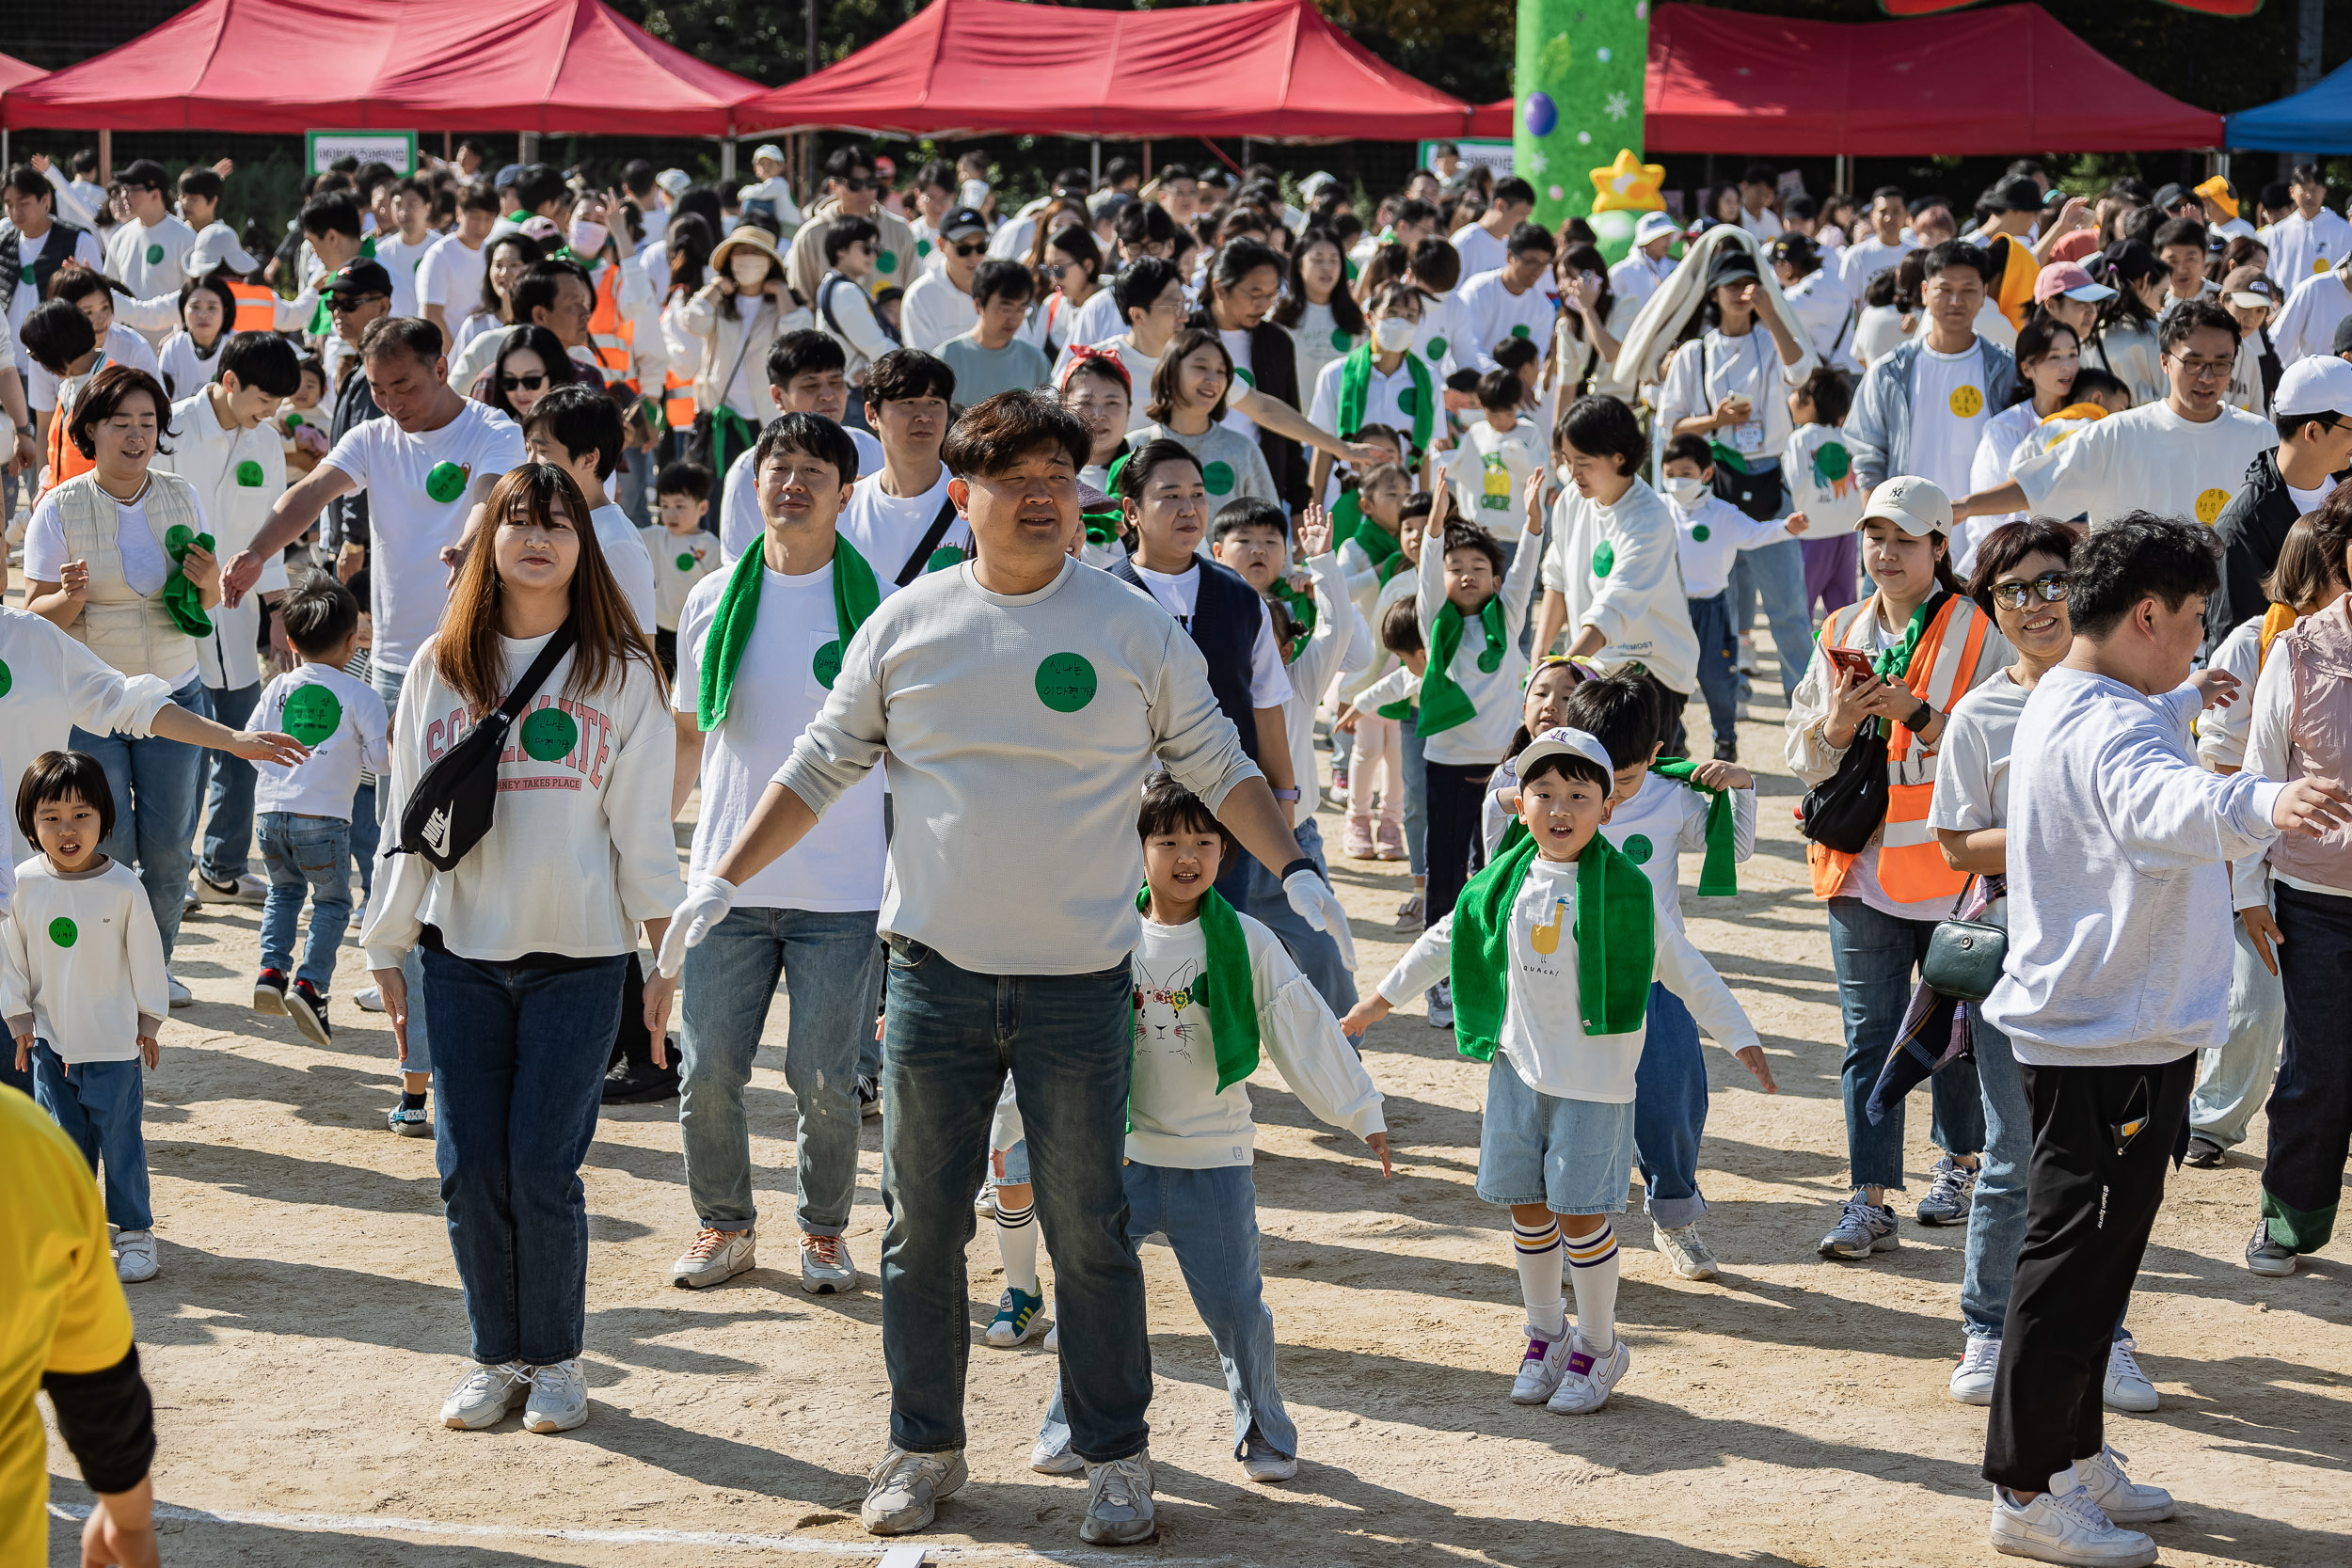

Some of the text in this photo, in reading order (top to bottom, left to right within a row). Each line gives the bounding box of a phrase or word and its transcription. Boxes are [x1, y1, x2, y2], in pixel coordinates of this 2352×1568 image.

[1049, 658, 1083, 676] 신나는
[1042, 685, 1079, 699] 이다현
[533, 713, 565, 732] 신나는
[522, 778, 550, 788] TAKES
[552, 778, 580, 789] PLACE
[421, 806, 447, 847] NIKE
